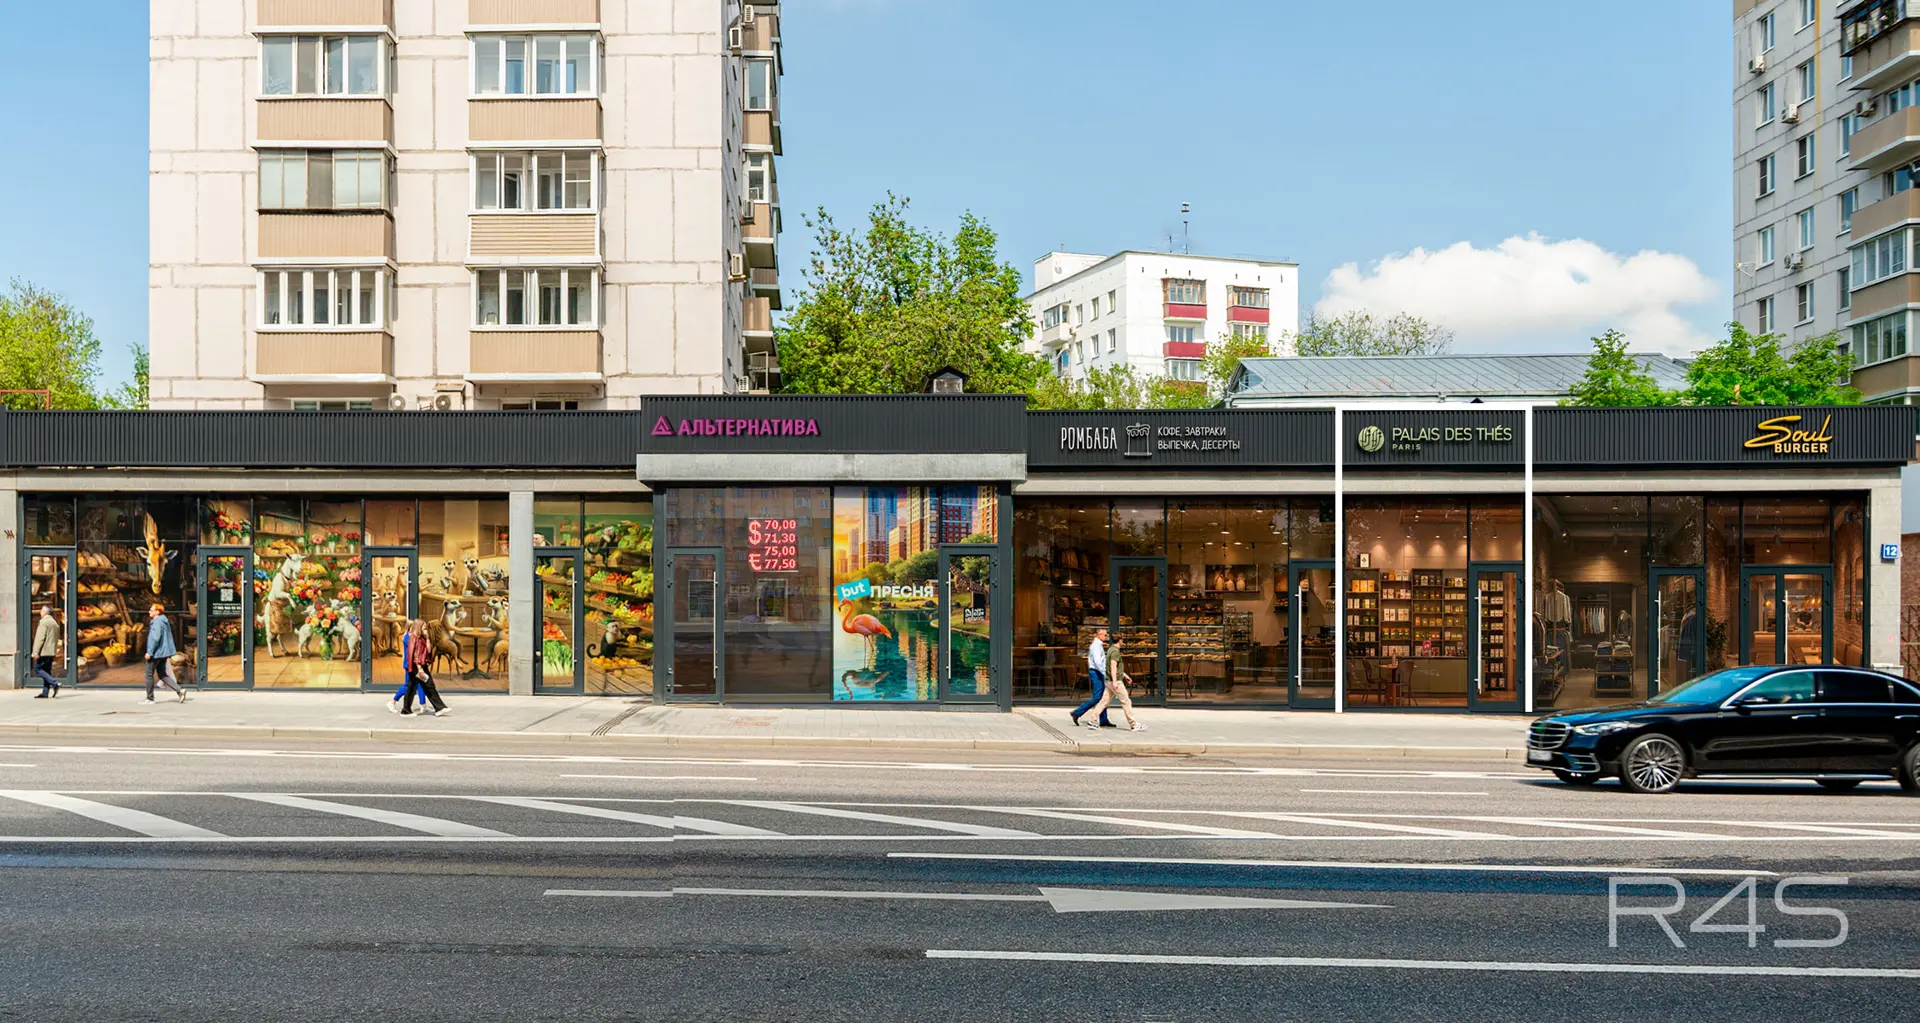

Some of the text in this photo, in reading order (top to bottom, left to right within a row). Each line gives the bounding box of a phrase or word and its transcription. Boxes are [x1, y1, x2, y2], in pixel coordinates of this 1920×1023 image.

[678, 419, 819, 436] АЛЬТЕРНАТИВА
[1157, 427, 1227, 438] КОФЕ, ЗАВТРАКИ
[1392, 425, 1512, 441] PALAIS DES THÉS
[1744, 414, 1833, 448] Soul
[1061, 427, 1118, 450] РОМБАБА
[1157, 440, 1240, 451] ВЫПЕЧКА, ДЕСЕРТЫ
[1774, 443, 1828, 453] BURGER
[764, 520, 796, 531] 70,00
[764, 533, 796, 544] 71,30
[764, 546, 796, 557] 75,00
[1885, 546, 1897, 556] 12
[764, 559, 796, 570] 77,50
[870, 585, 933, 598] ПРЕСНЯ
